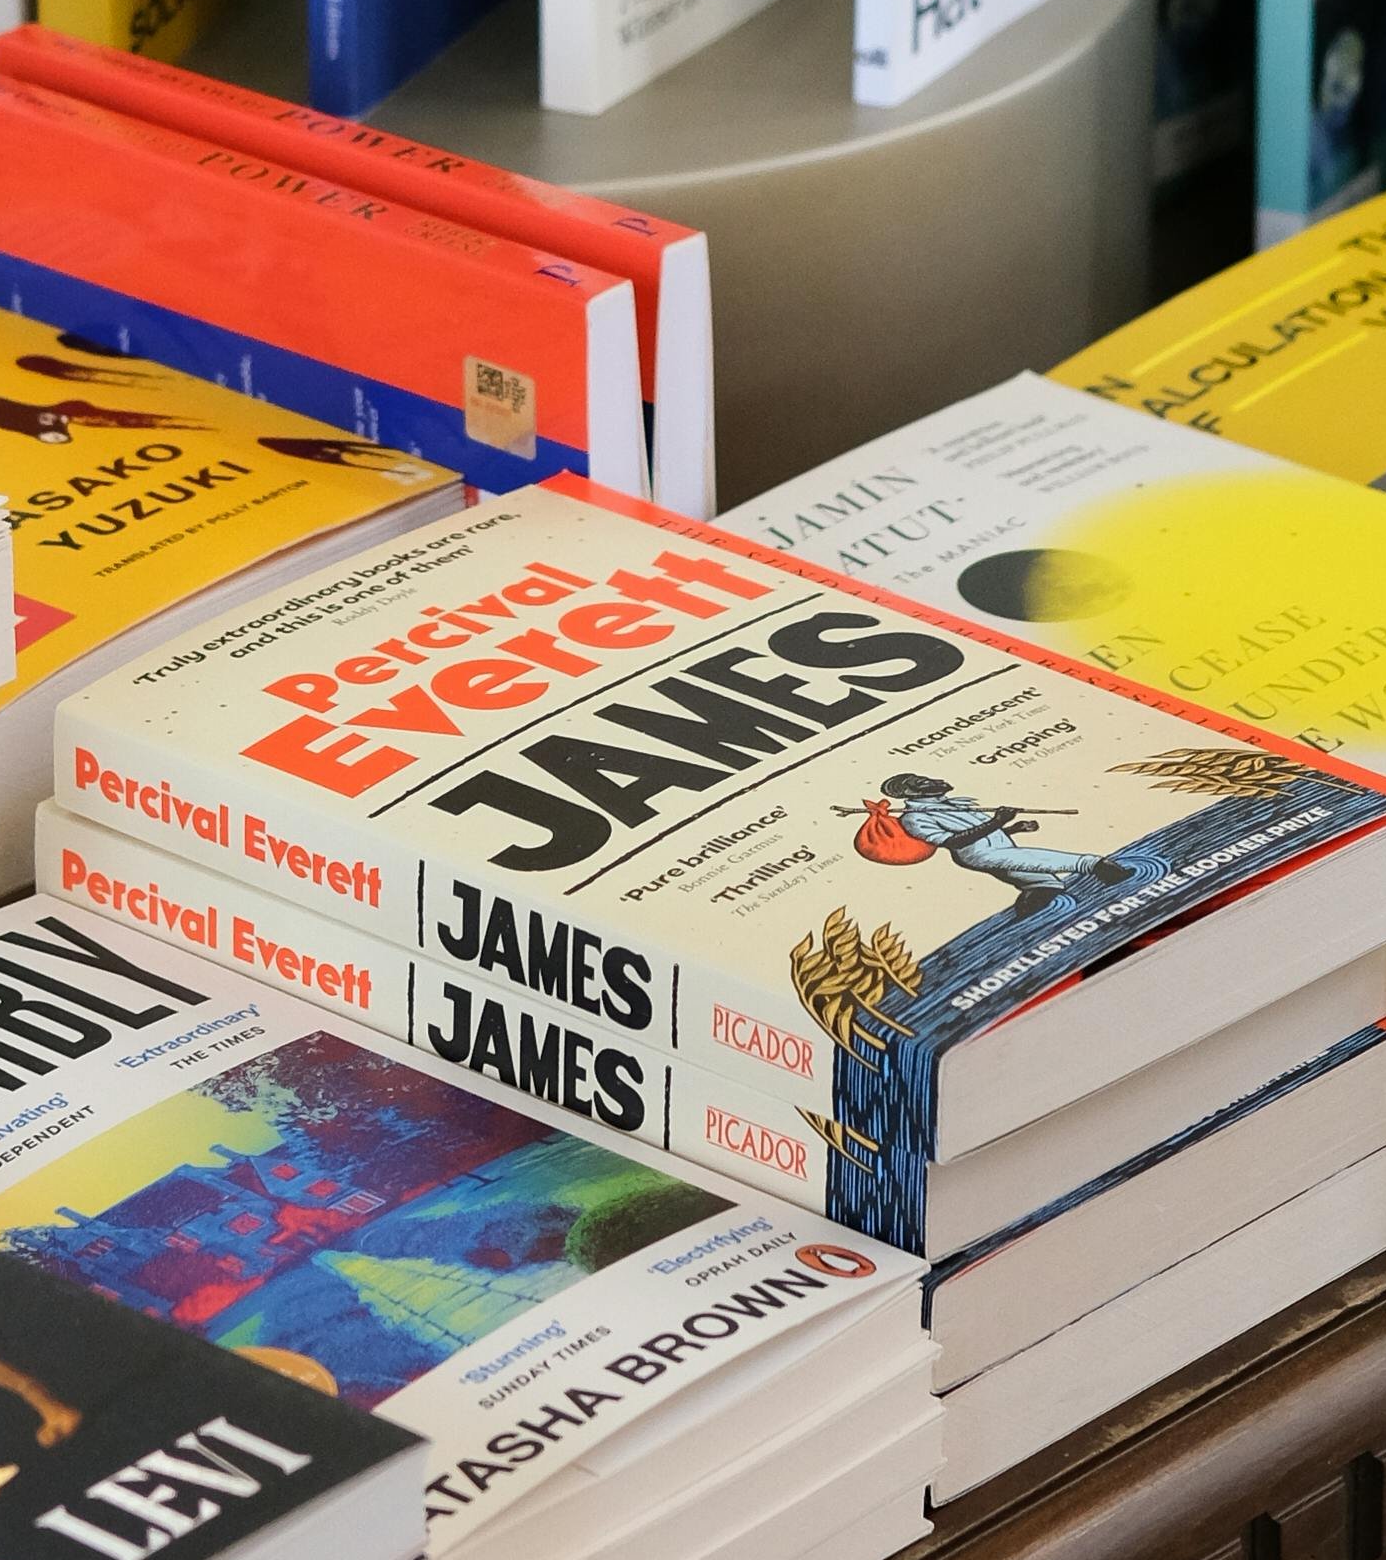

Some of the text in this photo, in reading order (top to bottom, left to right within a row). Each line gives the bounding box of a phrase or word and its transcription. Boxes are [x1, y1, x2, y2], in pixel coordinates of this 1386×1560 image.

[274, 107, 466, 176] POWER
[197, 151, 390, 222] POWER
[38, 460, 254, 552] YUZUKI
[936, 515, 1027, 564] MANIAC
[92, 532, 186, 579] TRANSLATED
[201, 512, 522, 652] extraordinary books are rare,
[230, 568, 412, 659] and this is one of
[262, 560, 596, 713] Percival
[331, 602, 380, 626] Roddy
[655, 516, 1264, 748] THE SUNDAY TIMES BESTSELLER
[1167, 604, 1327, 692] CEASE
[239, 551, 775, 798] Everett
[427, 612, 965, 873] JAMES
[929, 702, 1051, 761] The Times
[1010, 734, 1085, 770] The Observer
[74, 746, 383, 909] Percival Everett
[678, 832, 784, 896] Bonnie Garmus
[731, 851, 844, 920] The Sunday Times
[950, 806, 1334, 1014] SHORTLISTED FOR THE BOOKER PRIZE
[61, 848, 373, 1010] Percival Everett
[437, 881, 654, 1033] JAMES
[169, 1024, 266, 1072] THE TIMES
[427, 982, 647, 1134] JAMES
[712, 1005, 814, 1078] PICADOR
[705, 1107, 809, 1179] PICADOR
[684, 1230, 799, 1288] OPRAH DAILY
[477, 1325, 613, 1410] SUNDAY TIMES
[604, 1268, 828, 1385] BROWN
